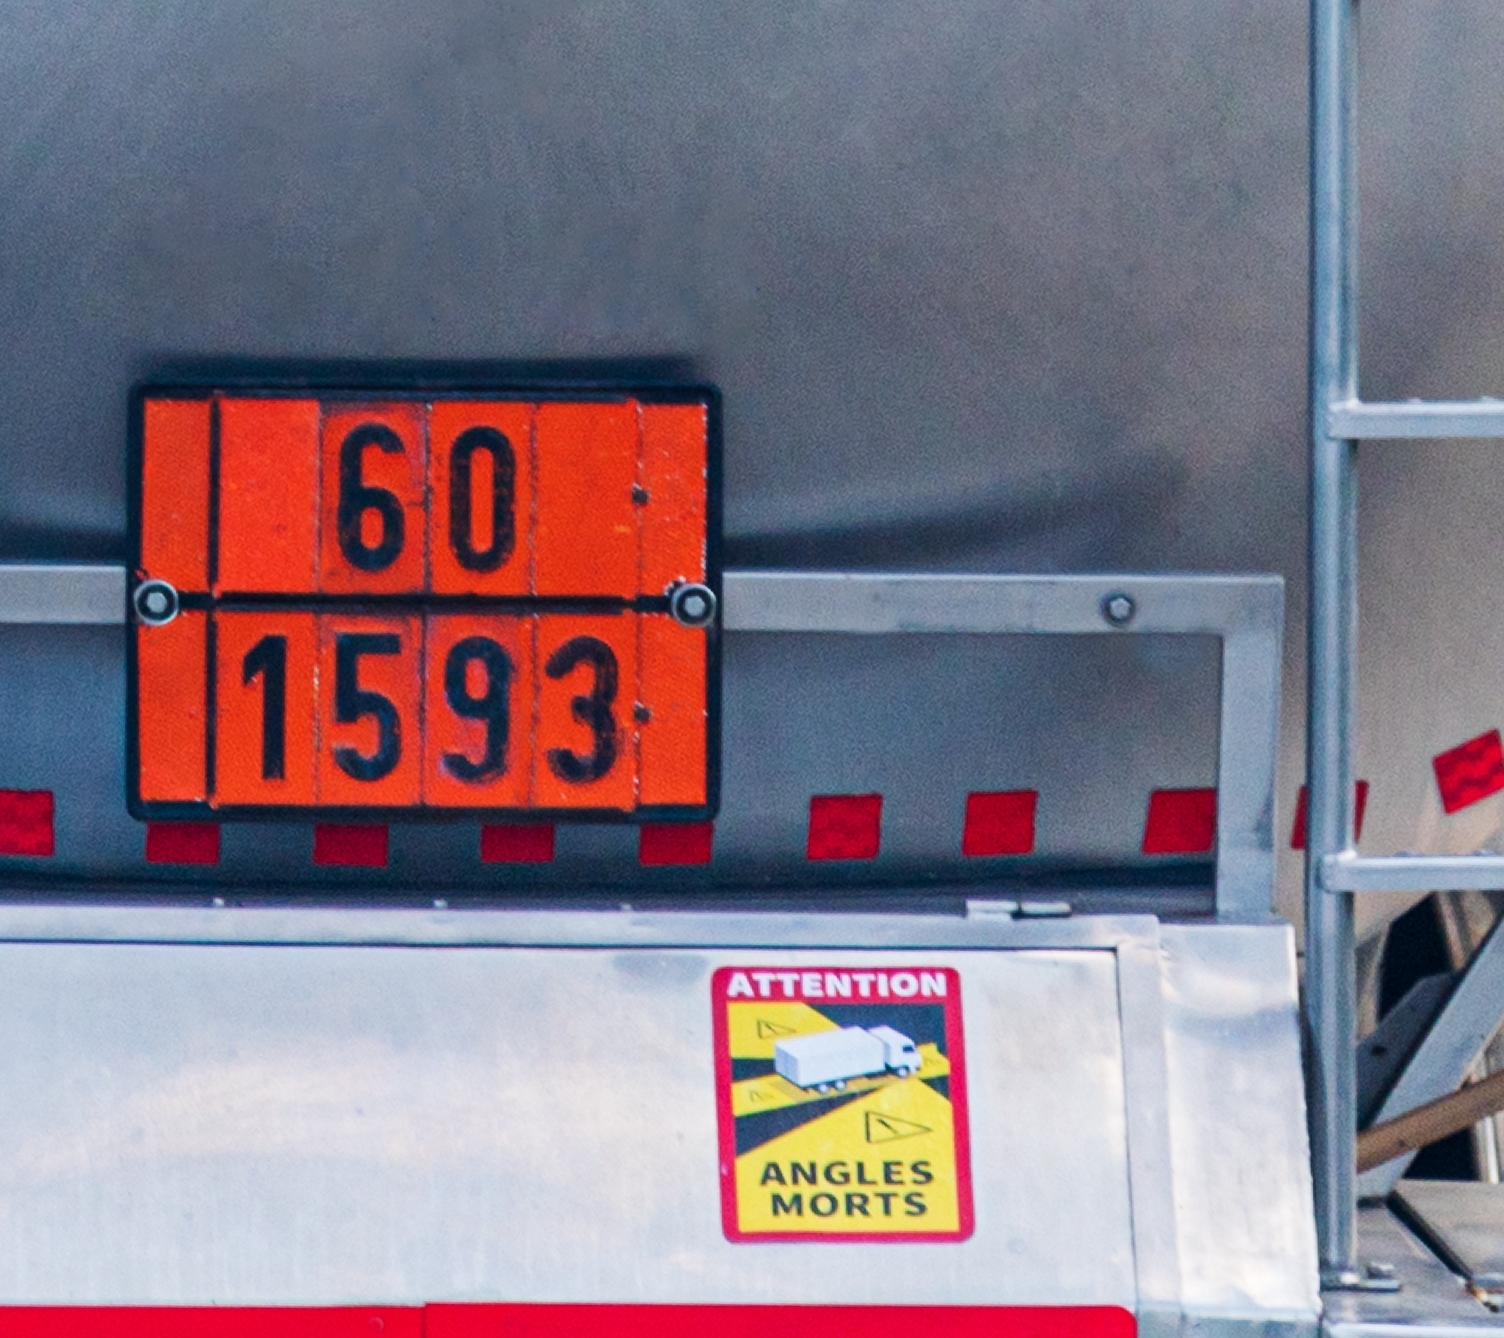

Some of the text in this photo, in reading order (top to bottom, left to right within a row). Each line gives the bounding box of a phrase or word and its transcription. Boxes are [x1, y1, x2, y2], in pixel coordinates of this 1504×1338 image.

[339, 423, 516, 573] 60
[243, 634, 619, 783] 1593
[727, 972, 947, 998] ATTENTION
[760, 1161, 934, 1185] ANGLES
[772, 1192, 928, 1217] MORTS
